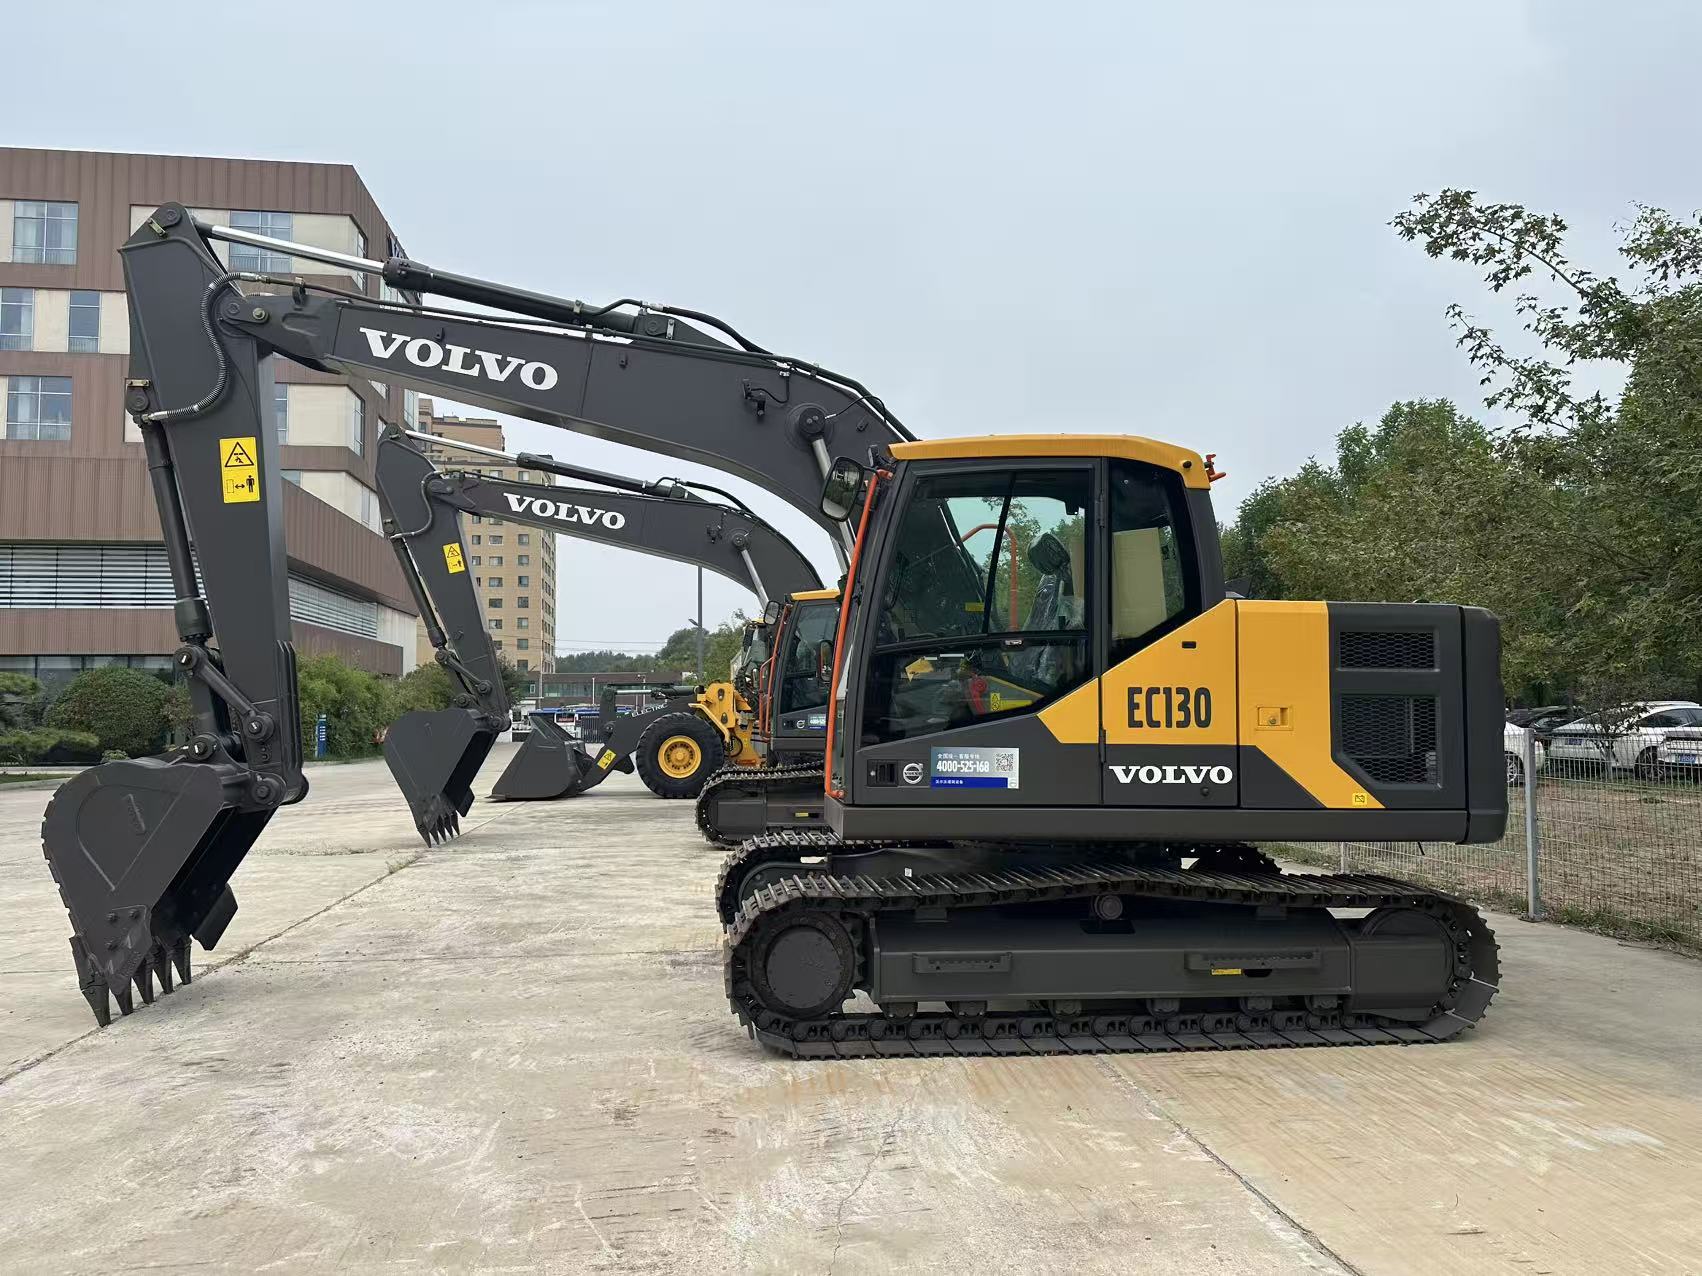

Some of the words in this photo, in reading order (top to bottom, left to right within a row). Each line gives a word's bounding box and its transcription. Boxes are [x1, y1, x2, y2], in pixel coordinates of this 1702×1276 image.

[359, 327, 558, 391] VOLVO
[503, 492, 626, 530] VOLVO
[1127, 686, 1212, 728] EC130
[936, 760, 990, 773] 4000-525-168
[1108, 765, 1233, 784] VOLVO
